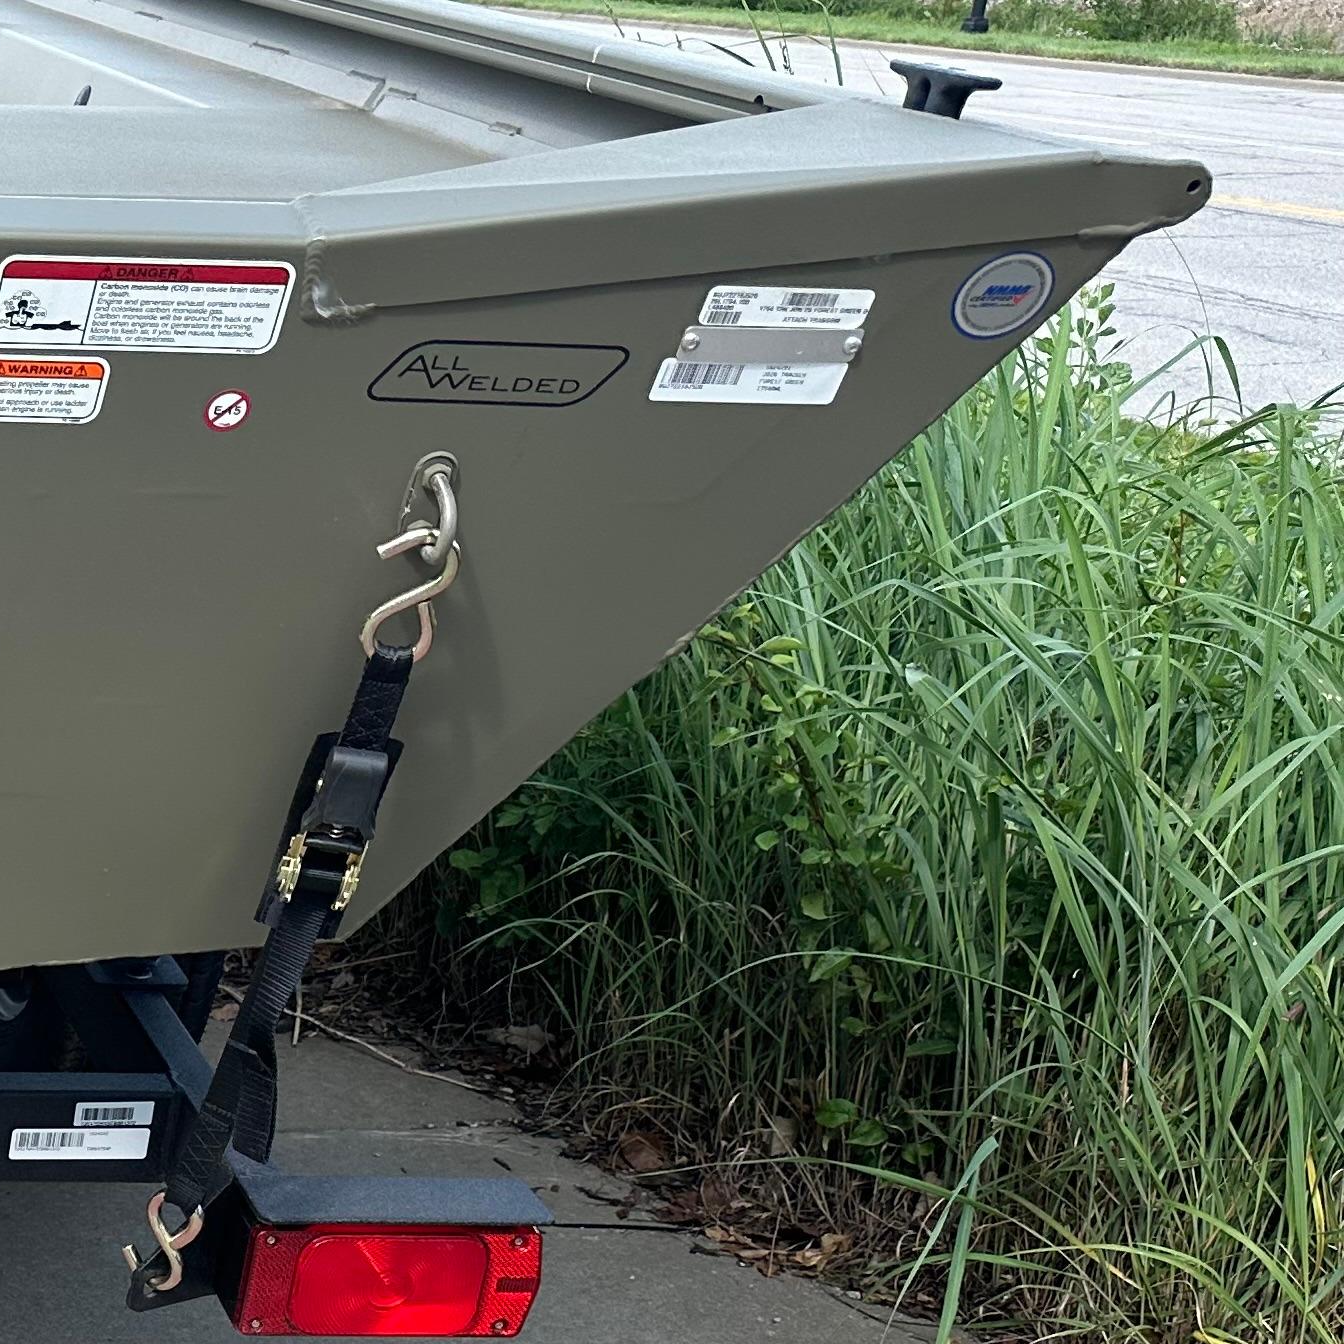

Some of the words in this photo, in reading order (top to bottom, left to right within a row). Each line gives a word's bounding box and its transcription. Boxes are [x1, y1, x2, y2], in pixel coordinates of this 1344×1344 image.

[116, 268, 179, 280] DANGER
[171, 284, 189, 293] (CO)
[250, 287, 279, 295] damage
[97, 298, 122, 308] Engine
[8, 364, 74, 376] WARNING
[398, 354, 470, 378] ALL
[18, 381, 50, 389] propeller
[427, 372, 581, 394] WELDED
